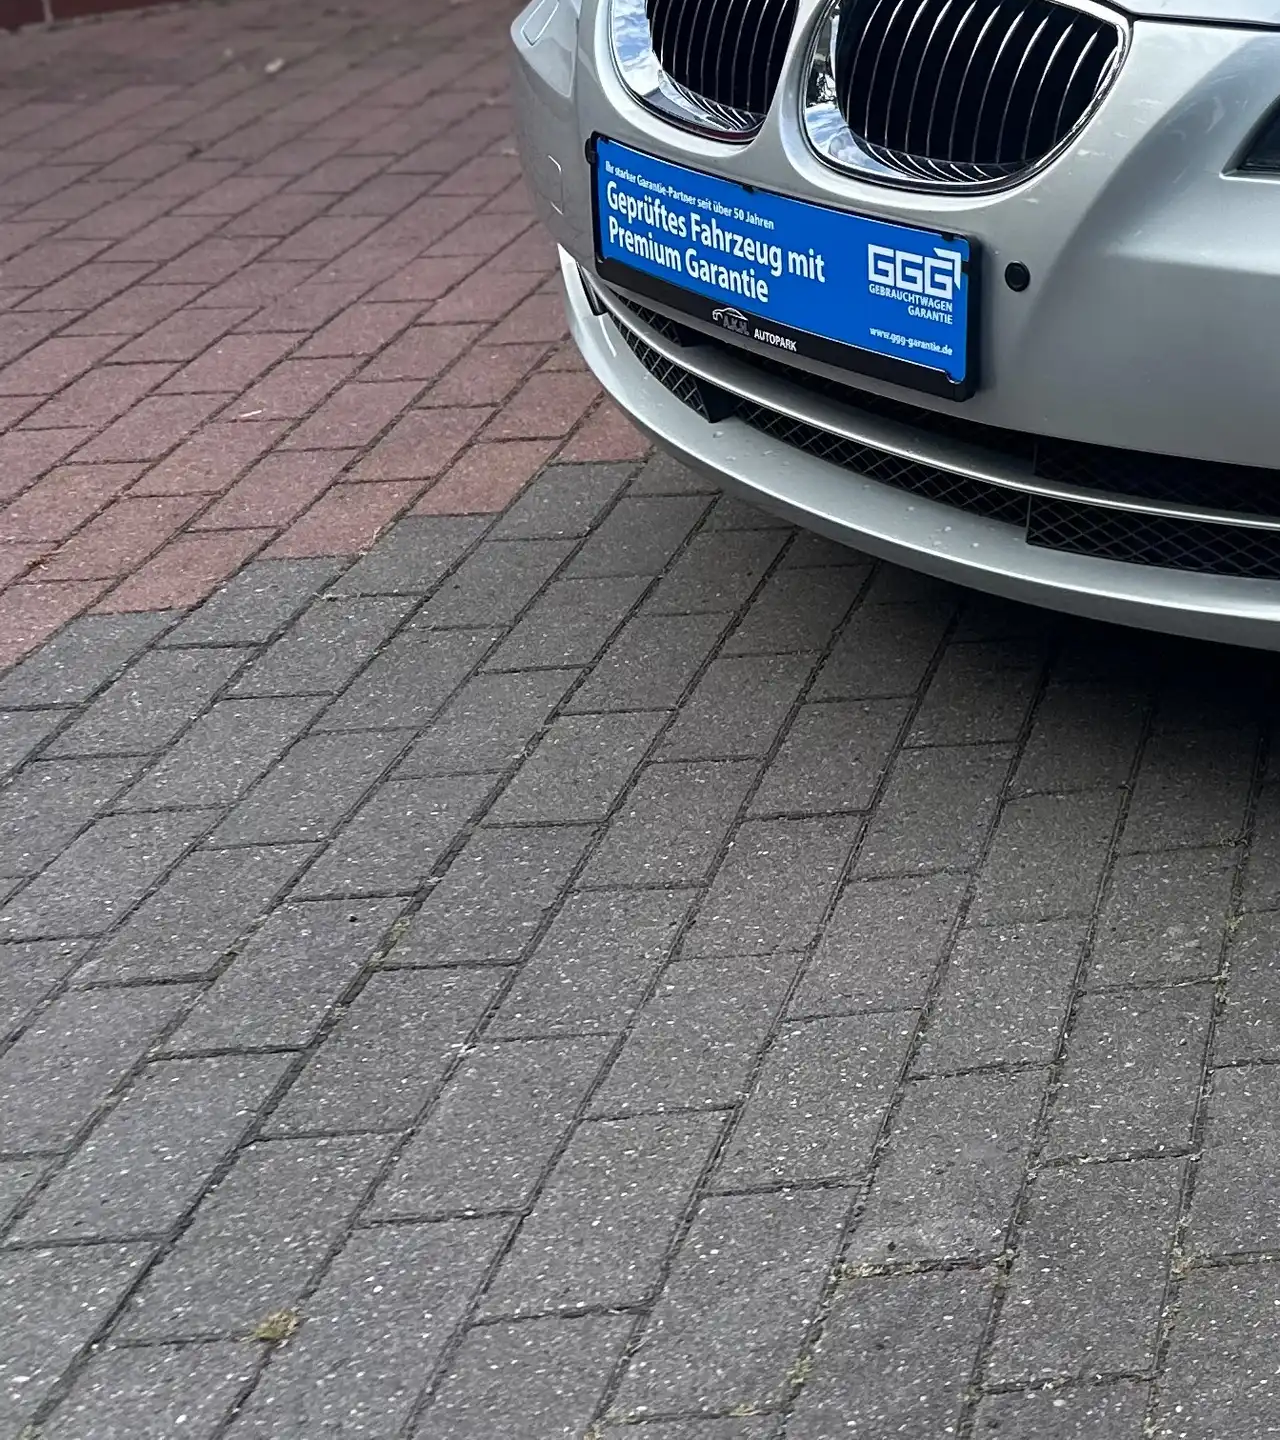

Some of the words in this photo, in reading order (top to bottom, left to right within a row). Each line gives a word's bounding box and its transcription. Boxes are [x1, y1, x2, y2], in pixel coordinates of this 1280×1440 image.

[605, 161, 615, 174] Ihr
[615, 167, 636, 184] starker
[637, 174, 696, 206] Garantie-Partner
[697, 197, 712, 210] seit
[713, 200, 732, 216] über
[733, 207, 744, 221] 50
[745, 210, 775, 230] Jahren
[607, 180, 687, 238] Geprüftes
[690, 212, 783, 277] Fahrzeug
[788, 248, 825, 283] mit
[609, 215, 682, 272] Premium
[685, 248, 769, 303] Garantie
[868, 244, 954, 300] GGG
[868, 283, 953, 312] GEBRAUCHTWAGEN
[907, 305, 953, 325] GARANTIE
[754, 328, 797, 352] AUTOPARK
[869, 327, 953, 356] www.ggg-garantie.de
